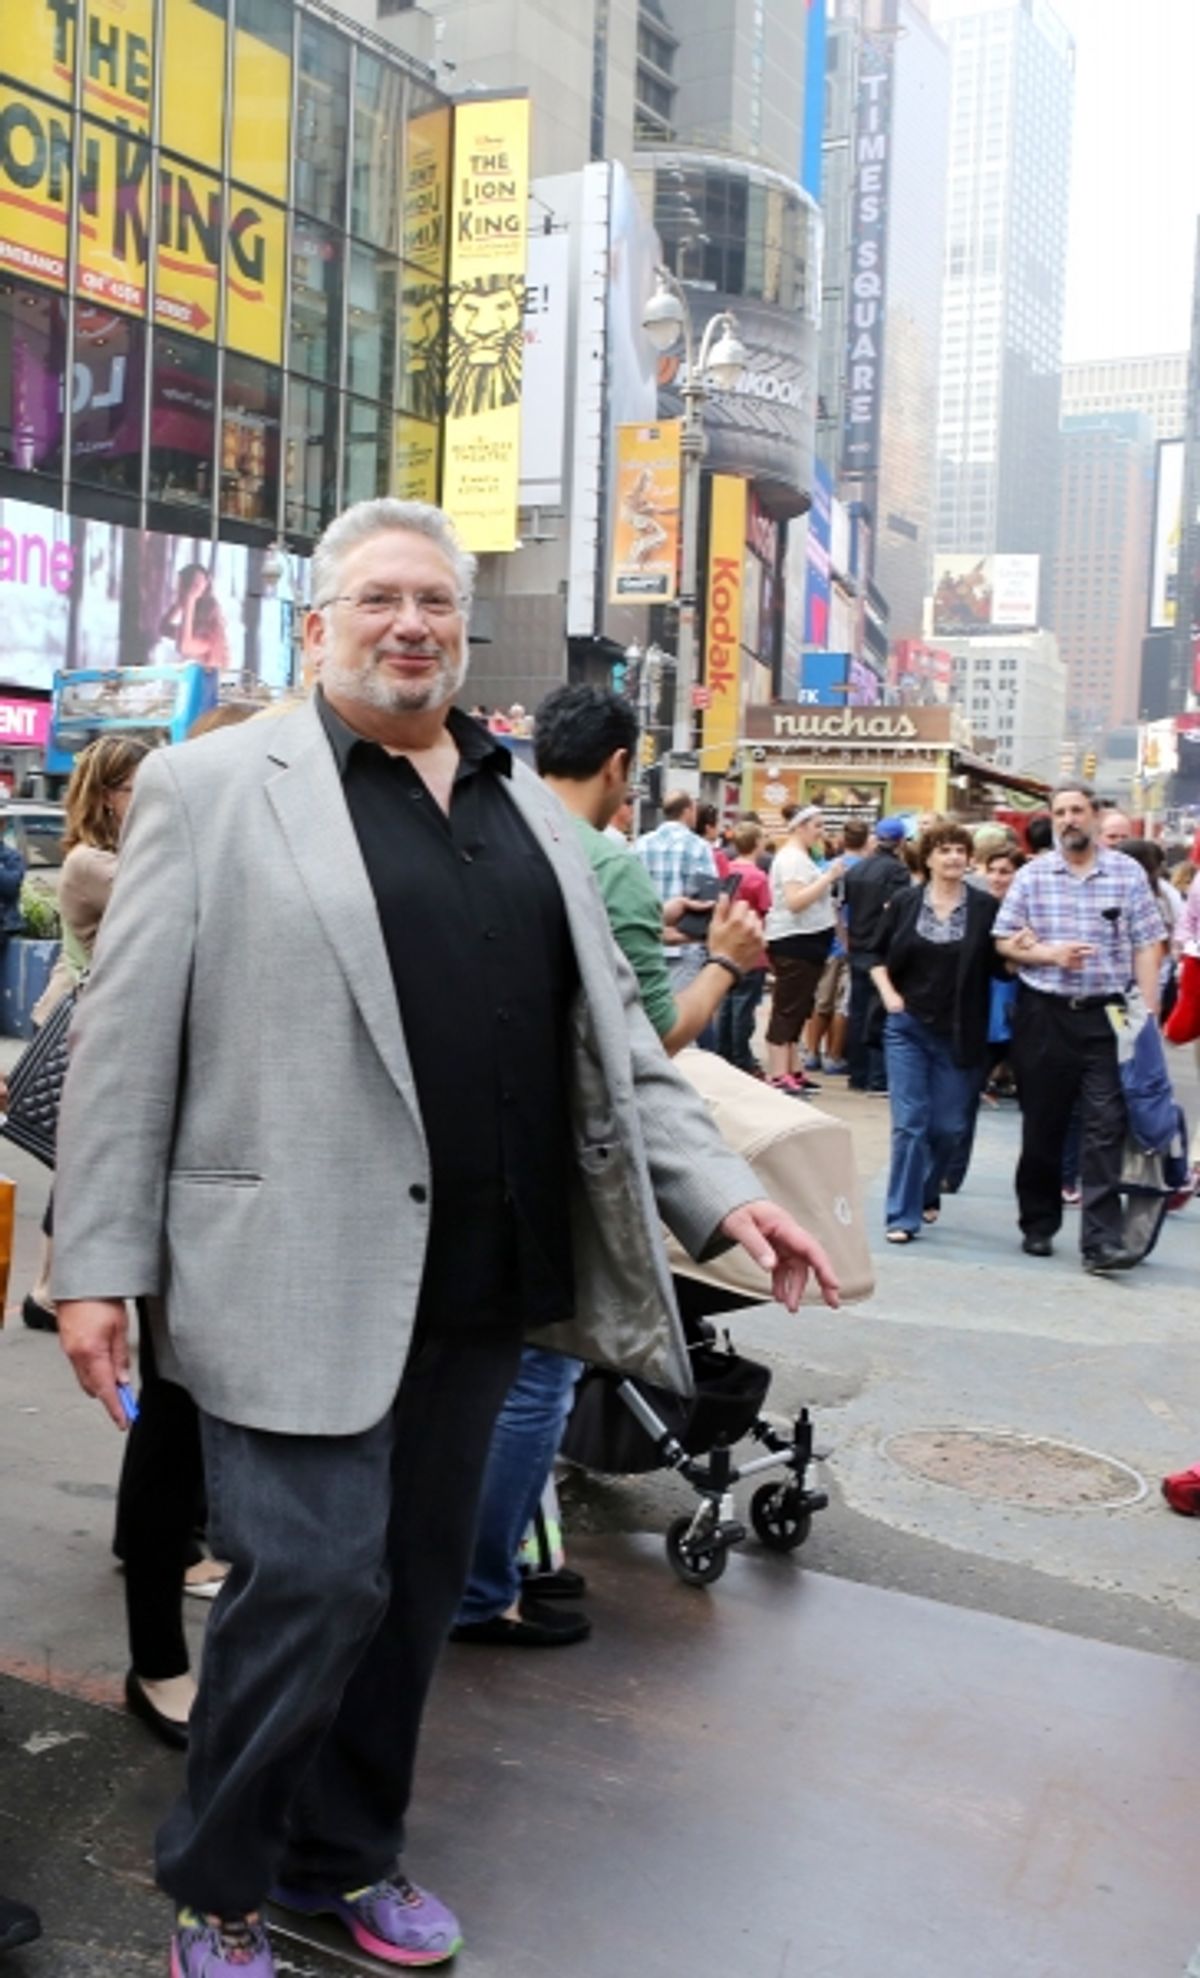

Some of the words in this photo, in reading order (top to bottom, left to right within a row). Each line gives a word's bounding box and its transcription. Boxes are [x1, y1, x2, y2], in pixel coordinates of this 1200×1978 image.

[47, 0, 149, 102] THE
[112, 116, 266, 284] KING
[462, 178, 516, 206] LION
[469, 152, 509, 172] THE
[858, 75, 888, 223] TIMES
[458, 211, 520, 242] KING
[850, 241, 882, 423] SQUARE
[709, 557, 741, 695] Kodak
[774, 707, 918, 737] nuchas
